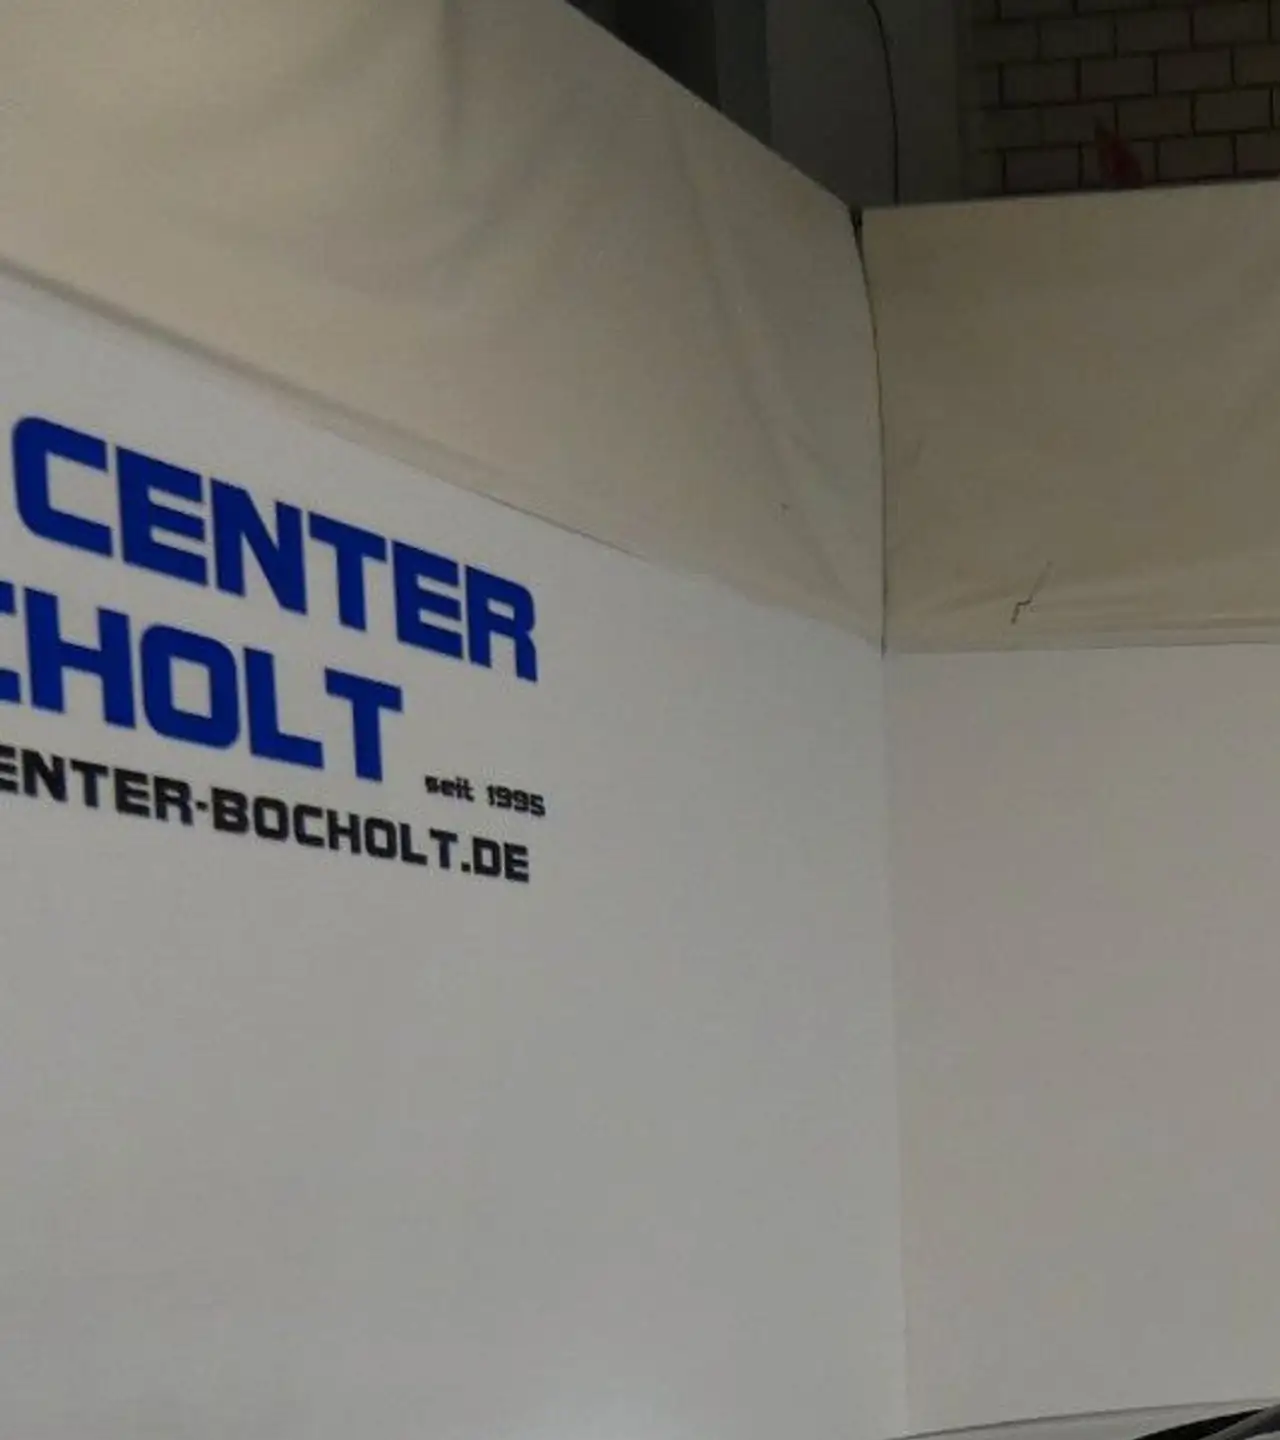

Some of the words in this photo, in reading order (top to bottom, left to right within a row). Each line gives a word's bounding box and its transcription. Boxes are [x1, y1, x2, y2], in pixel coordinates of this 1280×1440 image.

[13, 416, 538, 682] CENTER
[0, 579, 403, 782] HOLT
[424, 775, 475, 801] seit
[486, 784, 546, 817] 1995
